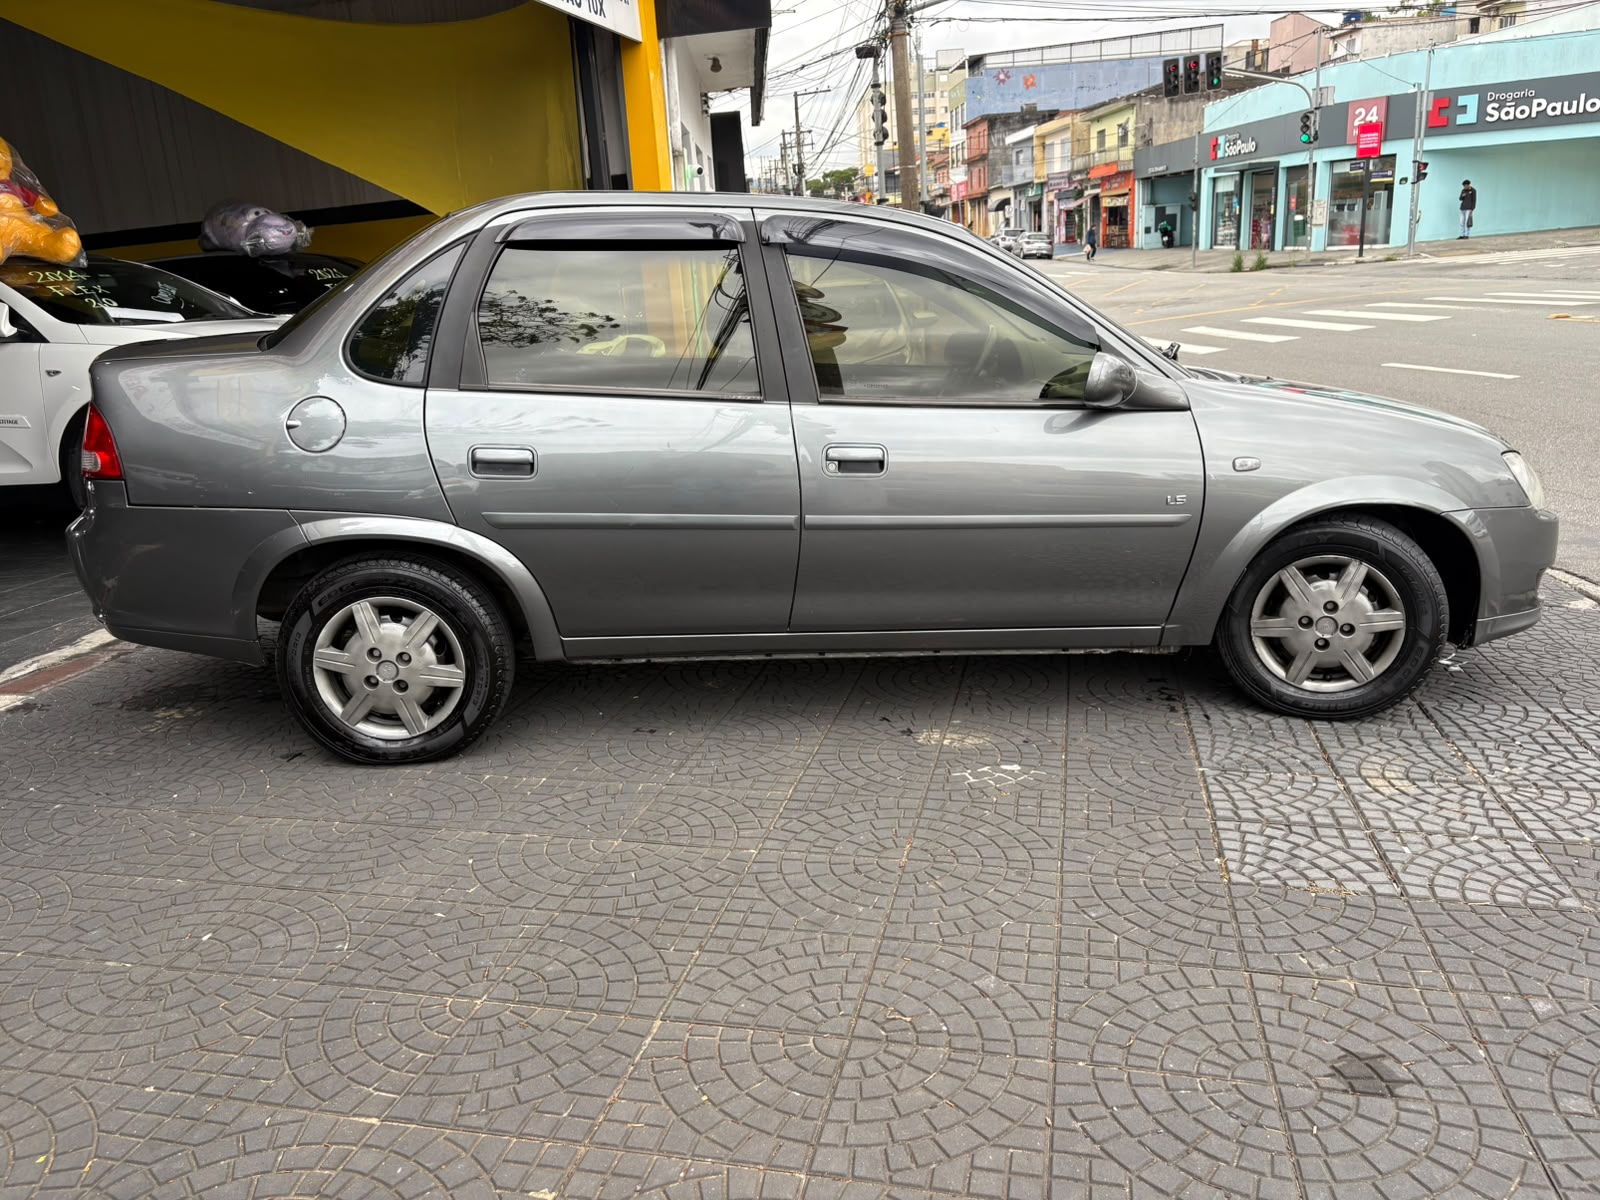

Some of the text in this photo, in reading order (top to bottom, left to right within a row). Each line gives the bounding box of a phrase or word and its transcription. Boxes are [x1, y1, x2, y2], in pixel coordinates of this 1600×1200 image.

[1487, 88, 1535, 102] Drogaria
[1353, 105, 1379, 127] 24
[27, 268, 91, 283] 2014
[46, 284, 111, 297] FLEX
